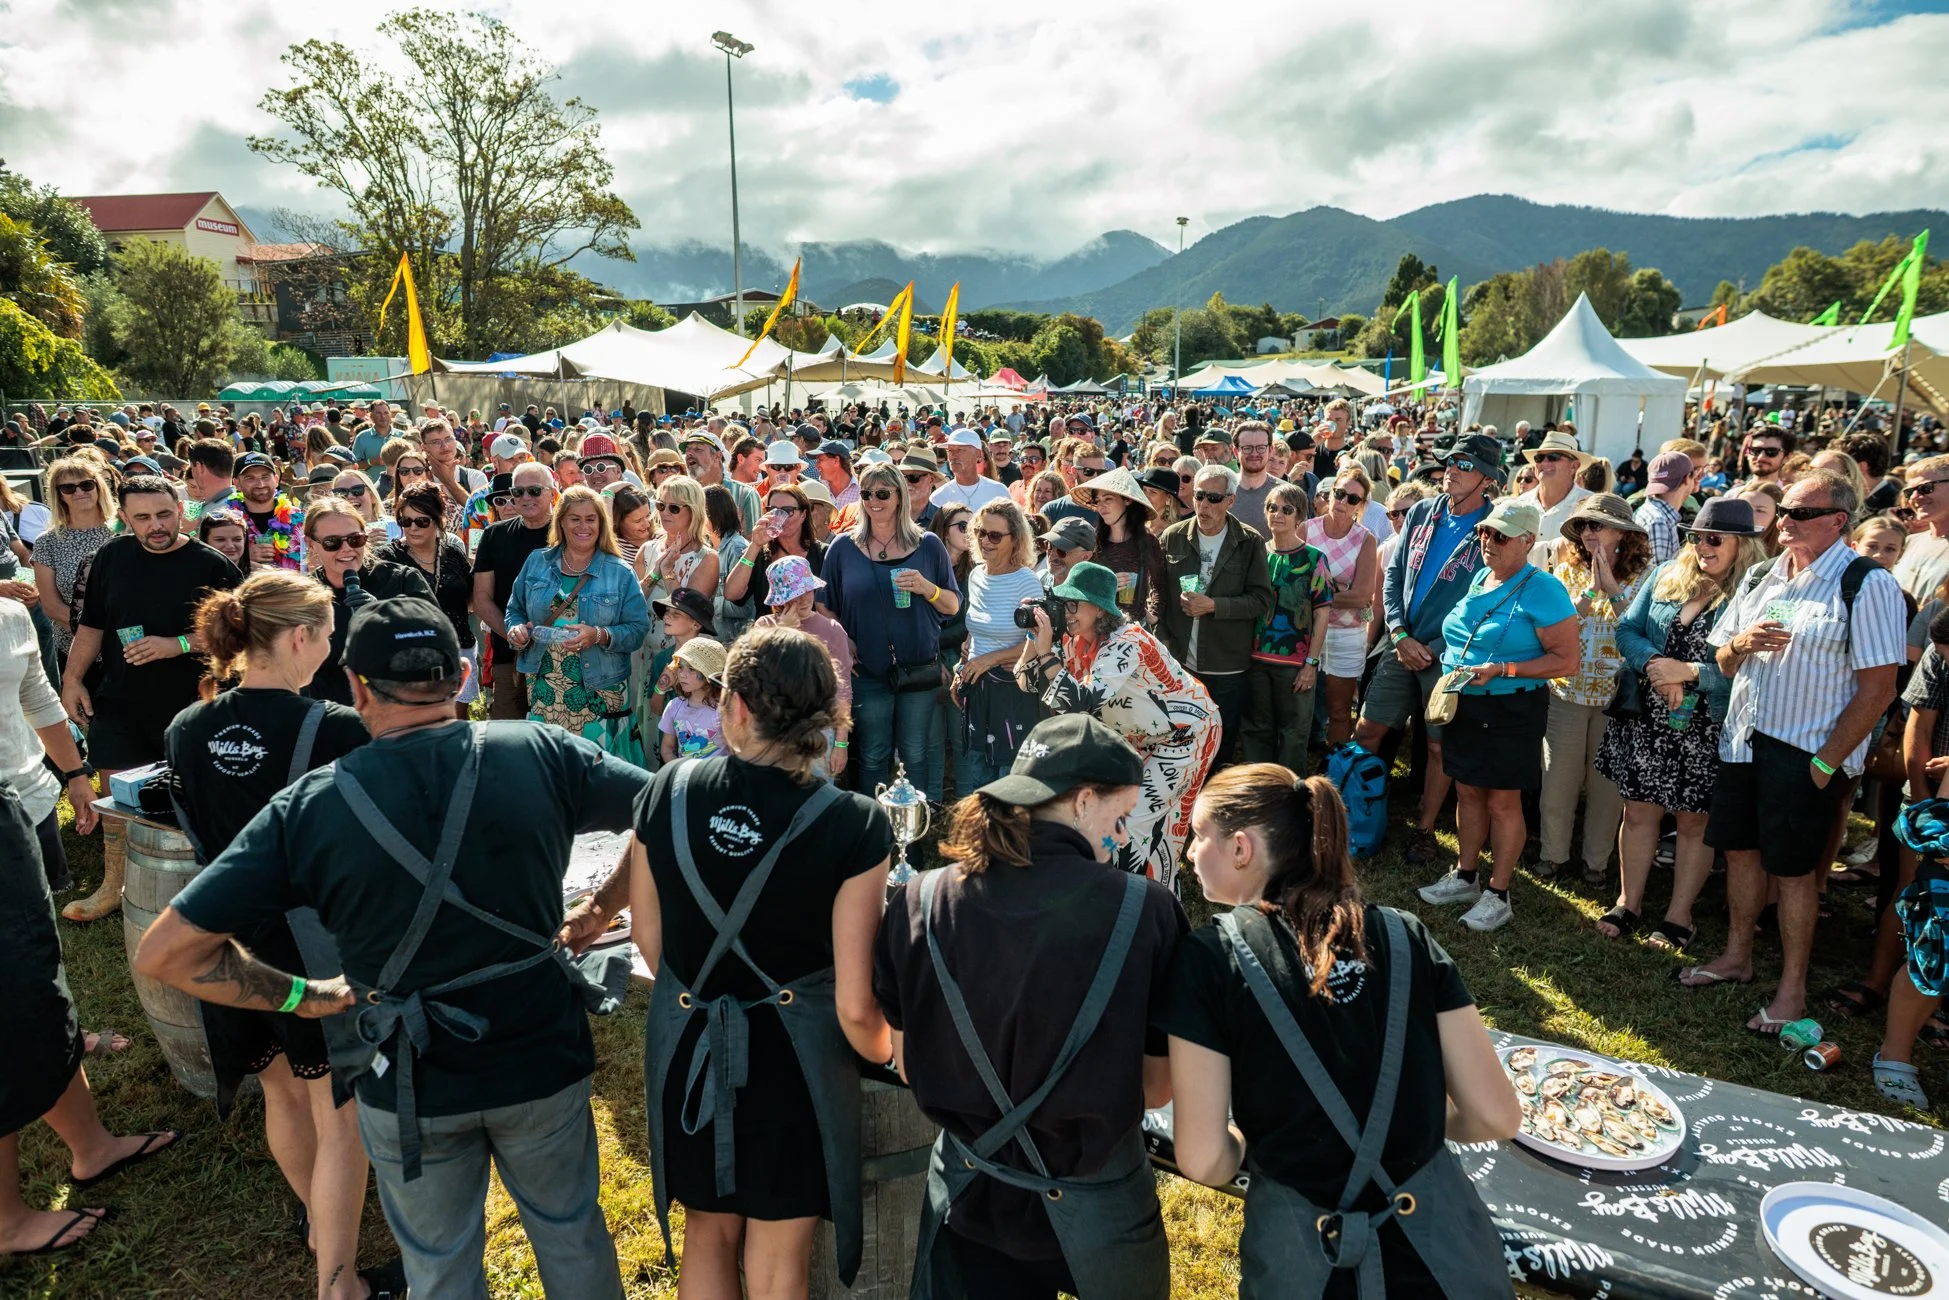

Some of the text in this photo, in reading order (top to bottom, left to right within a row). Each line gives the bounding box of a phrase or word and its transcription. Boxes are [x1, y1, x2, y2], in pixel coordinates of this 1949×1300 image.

[198, 220, 238, 234] museum
[208, 741, 269, 760] Mills Bay
[709, 815, 763, 846] Mills Bay
[1676, 1080, 1714, 1102] PREMIUM
[1691, 1115, 1796, 1139] EXPORT QUALITY
[1693, 1143, 1842, 1171] Mills Bay
[1842, 1134, 1944, 1160] PREMIUM GRADE
[1468, 1156, 1497, 1182] PREMI
[1660, 1165, 1692, 1180] EXP
[1615, 1184, 1670, 1192] MUSSELS
[1737, 1174, 1772, 1192] ADE
[1505, 1203, 1572, 1231] EXPORT
[1577, 1188, 1736, 1223] Mills Bay
[1500, 1231, 1547, 1240] MUSSEL
[1621, 1222, 1738, 1256] PREMIUM GRADE
[1522, 1238, 1614, 1280] Mills
[1848, 1230, 1887, 1288] Mills Bay
